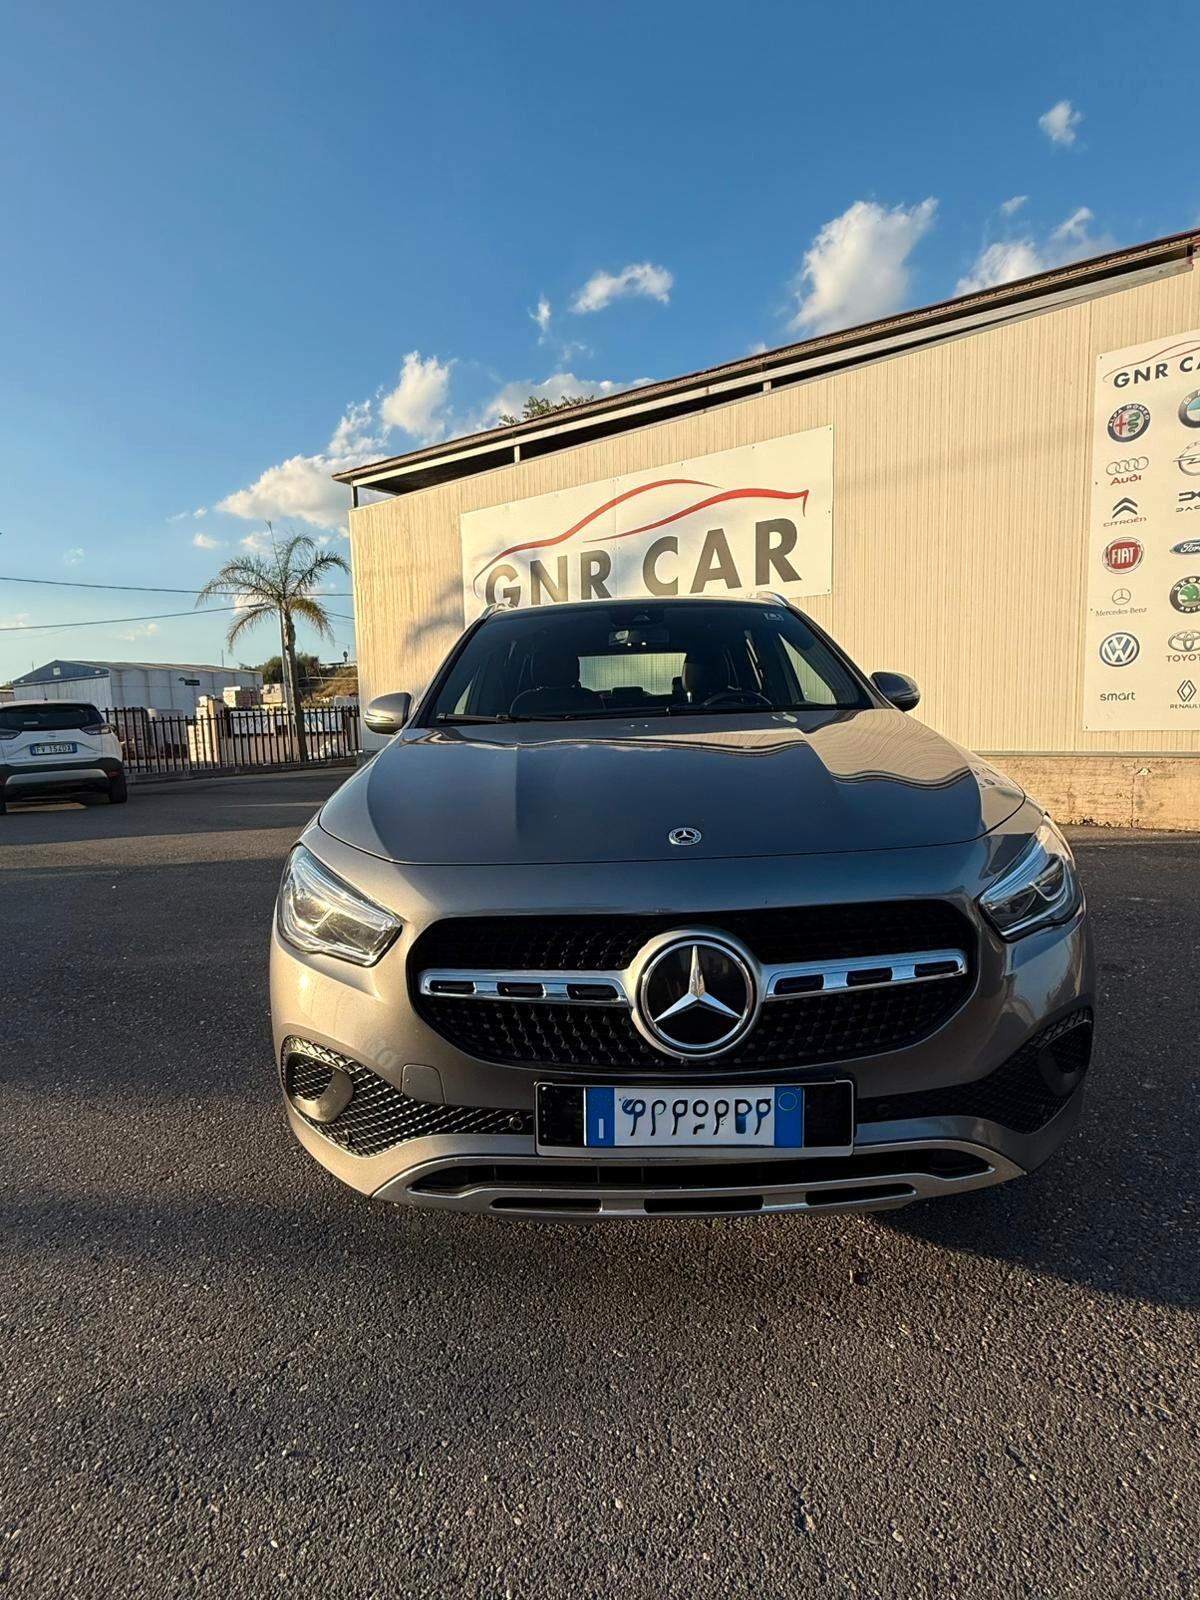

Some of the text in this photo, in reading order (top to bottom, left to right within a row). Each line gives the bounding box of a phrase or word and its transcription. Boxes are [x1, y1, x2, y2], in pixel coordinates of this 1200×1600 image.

[1113, 363, 1168, 388] GNR
[1110, 474, 1142, 486] Audi
[485, 517, 803, 608] GNR CAR
[1111, 547, 1135, 564] FIAT
[1100, 691, 1136, 701] smart
